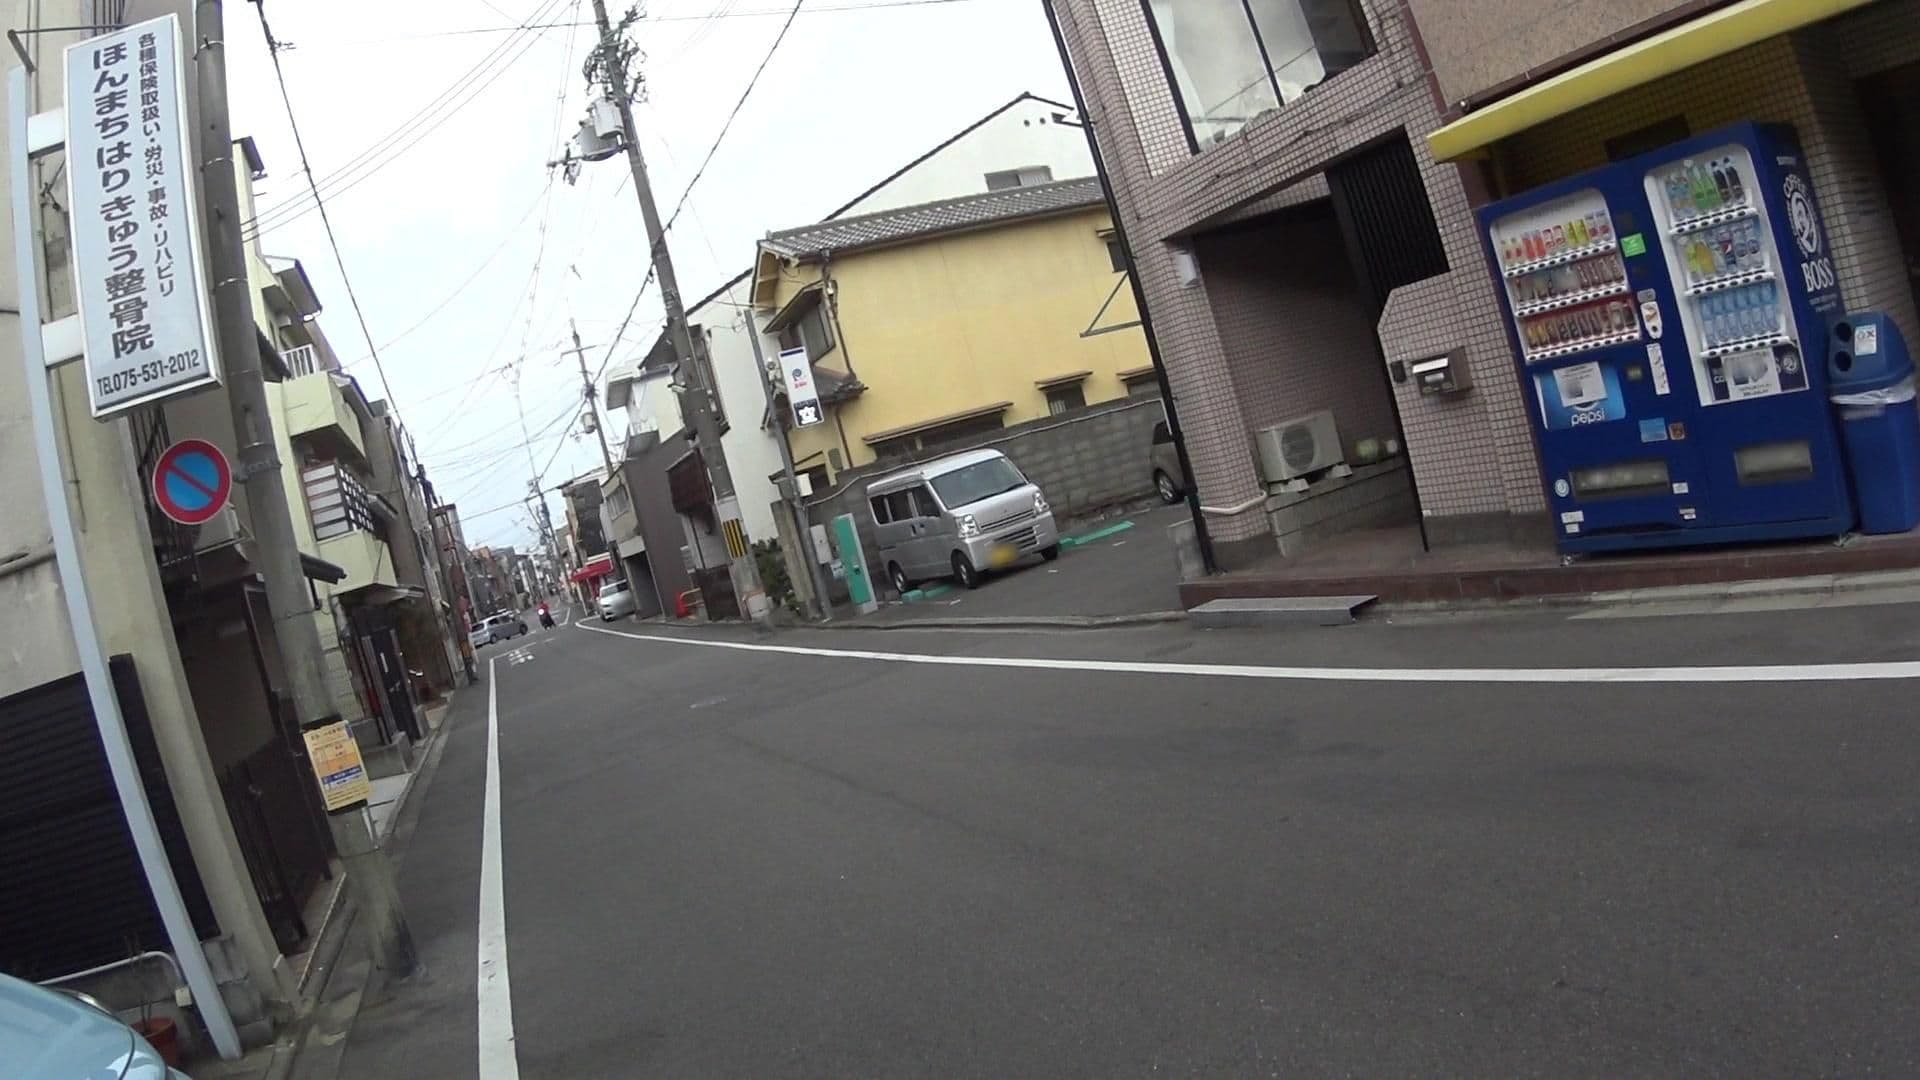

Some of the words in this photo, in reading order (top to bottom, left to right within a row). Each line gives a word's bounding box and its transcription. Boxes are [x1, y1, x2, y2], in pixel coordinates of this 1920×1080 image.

[93, 42, 154, 359] ほんまちはりきゅう整骨院
[1801, 257, 1835, 293] BOSS
[1571, 408, 1605, 427] pepsi
